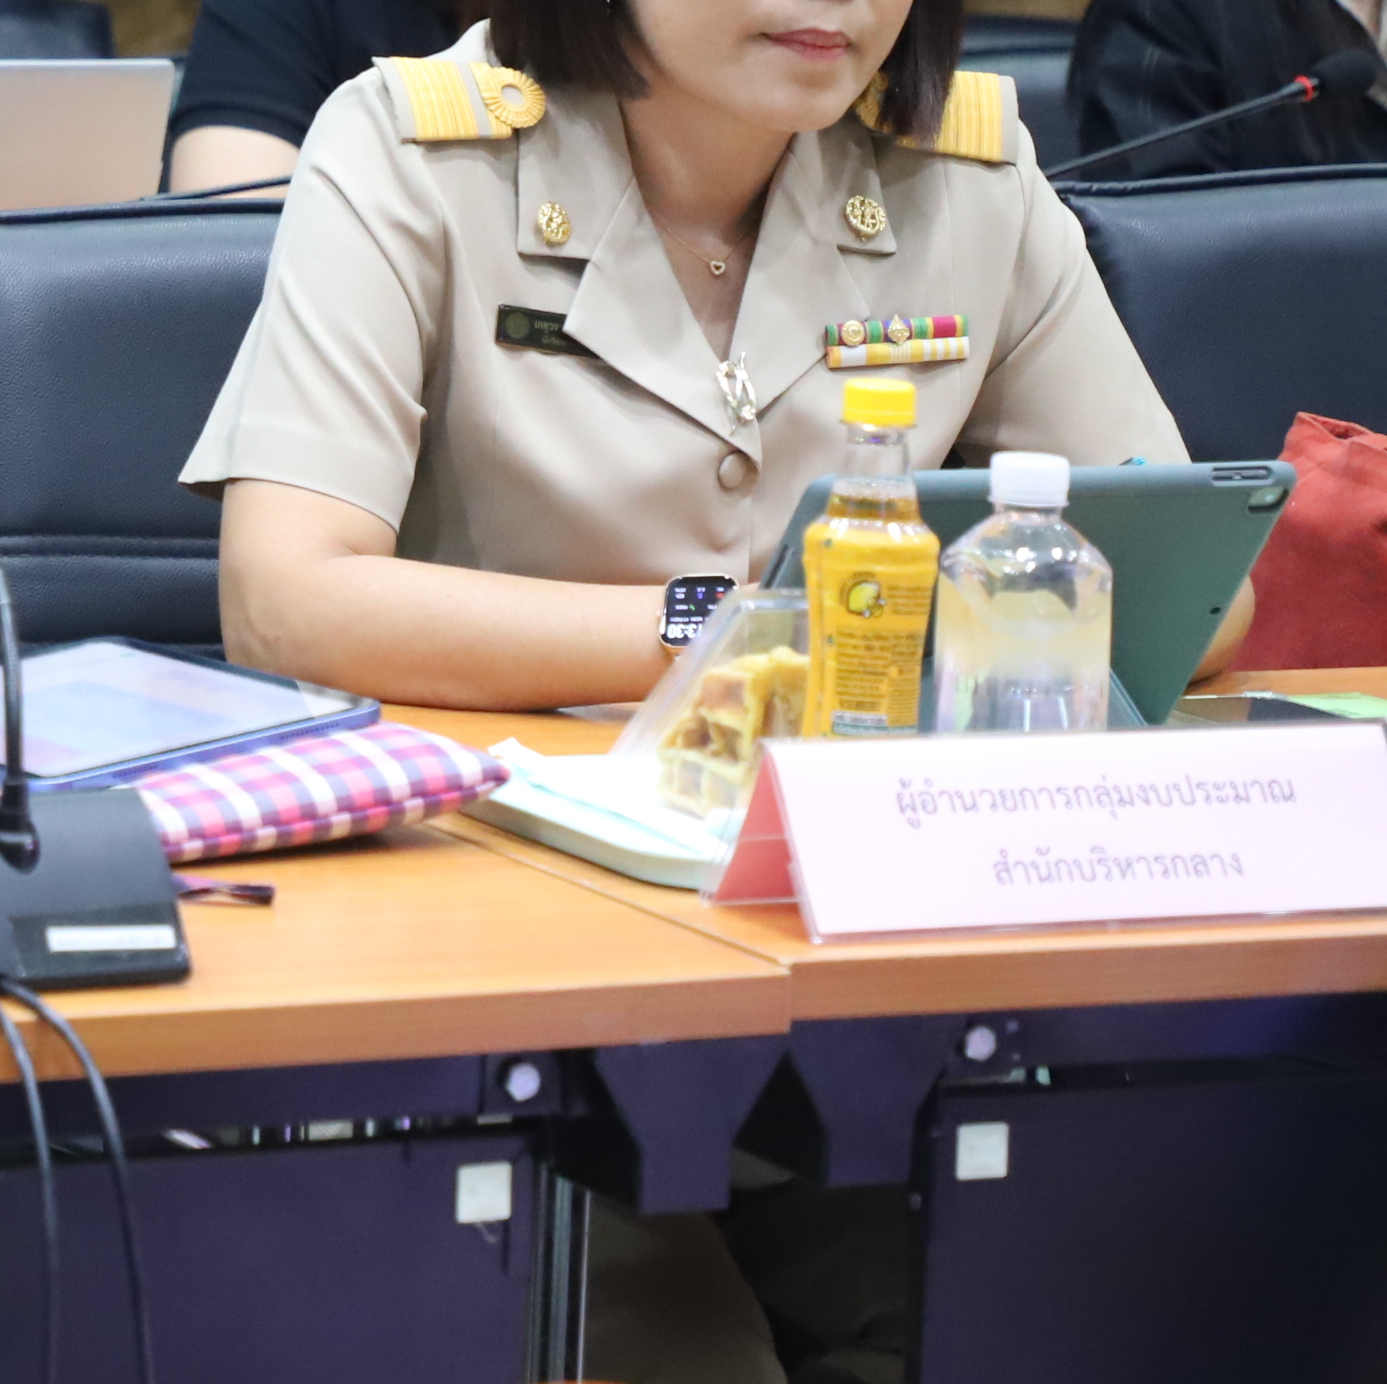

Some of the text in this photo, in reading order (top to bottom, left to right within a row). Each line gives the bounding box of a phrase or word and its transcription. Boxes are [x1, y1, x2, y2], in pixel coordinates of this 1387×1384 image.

[893, 774, 1298, 831] ผู้อำนวยการกลุ่มงบประมาณ
[990, 844, 1246, 887] สำนักบริหารกลาง
